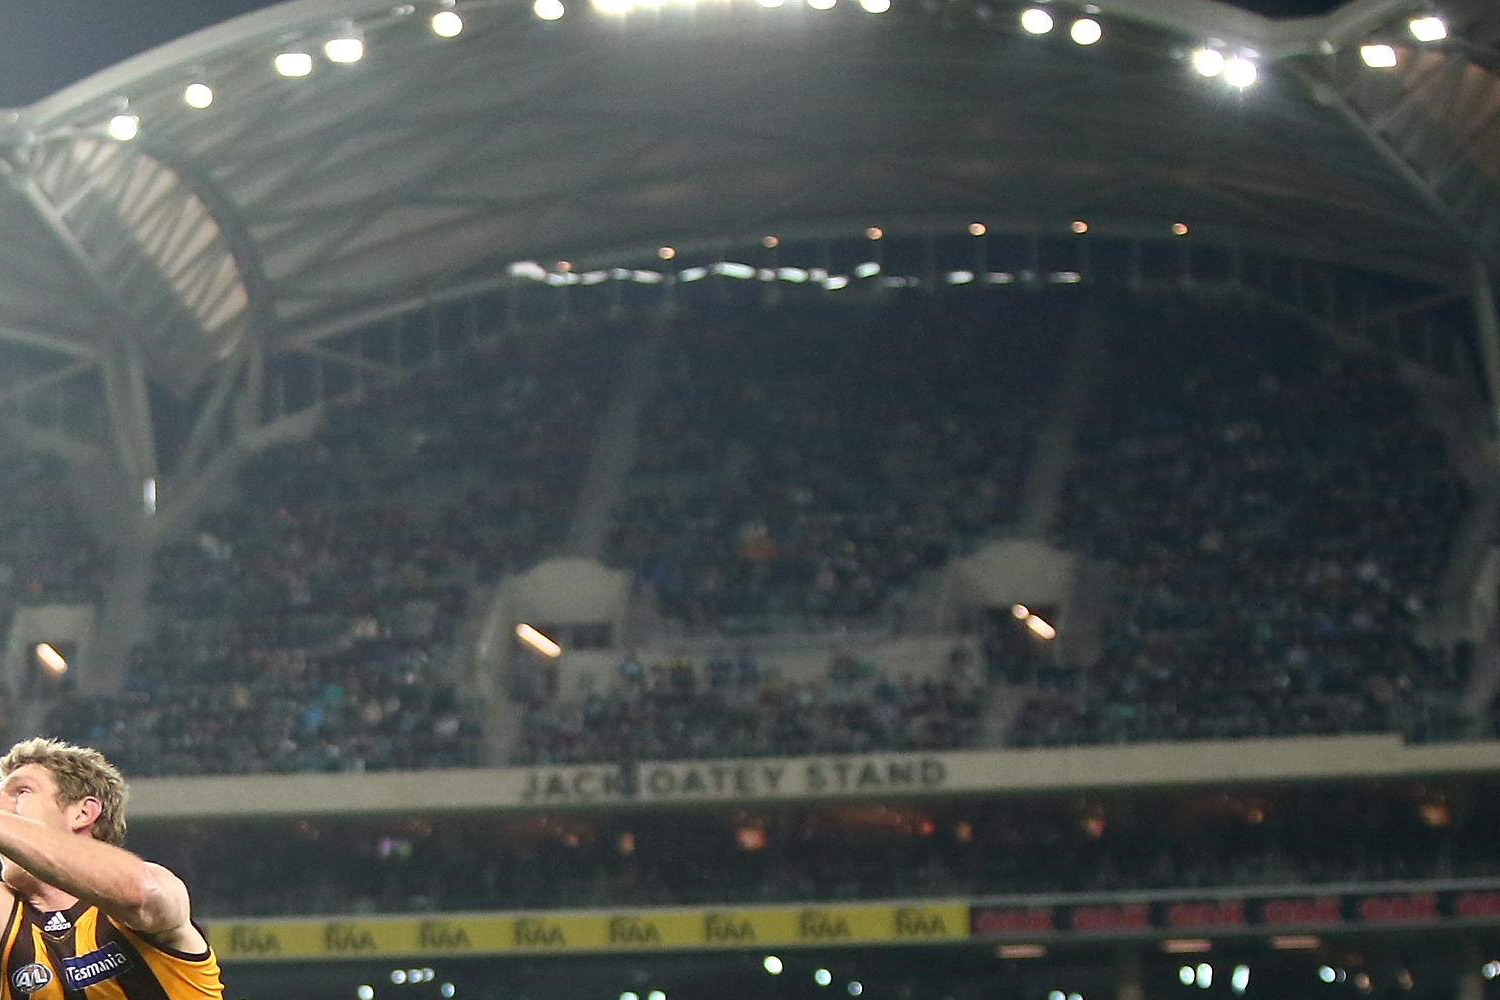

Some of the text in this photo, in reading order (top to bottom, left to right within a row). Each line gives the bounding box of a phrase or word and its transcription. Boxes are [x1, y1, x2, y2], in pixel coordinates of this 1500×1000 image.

[522, 760, 946, 799] JACK OATEY STAND
[44, 921, 72, 932] adidas
[66, 952, 127, 982] Tasmania
